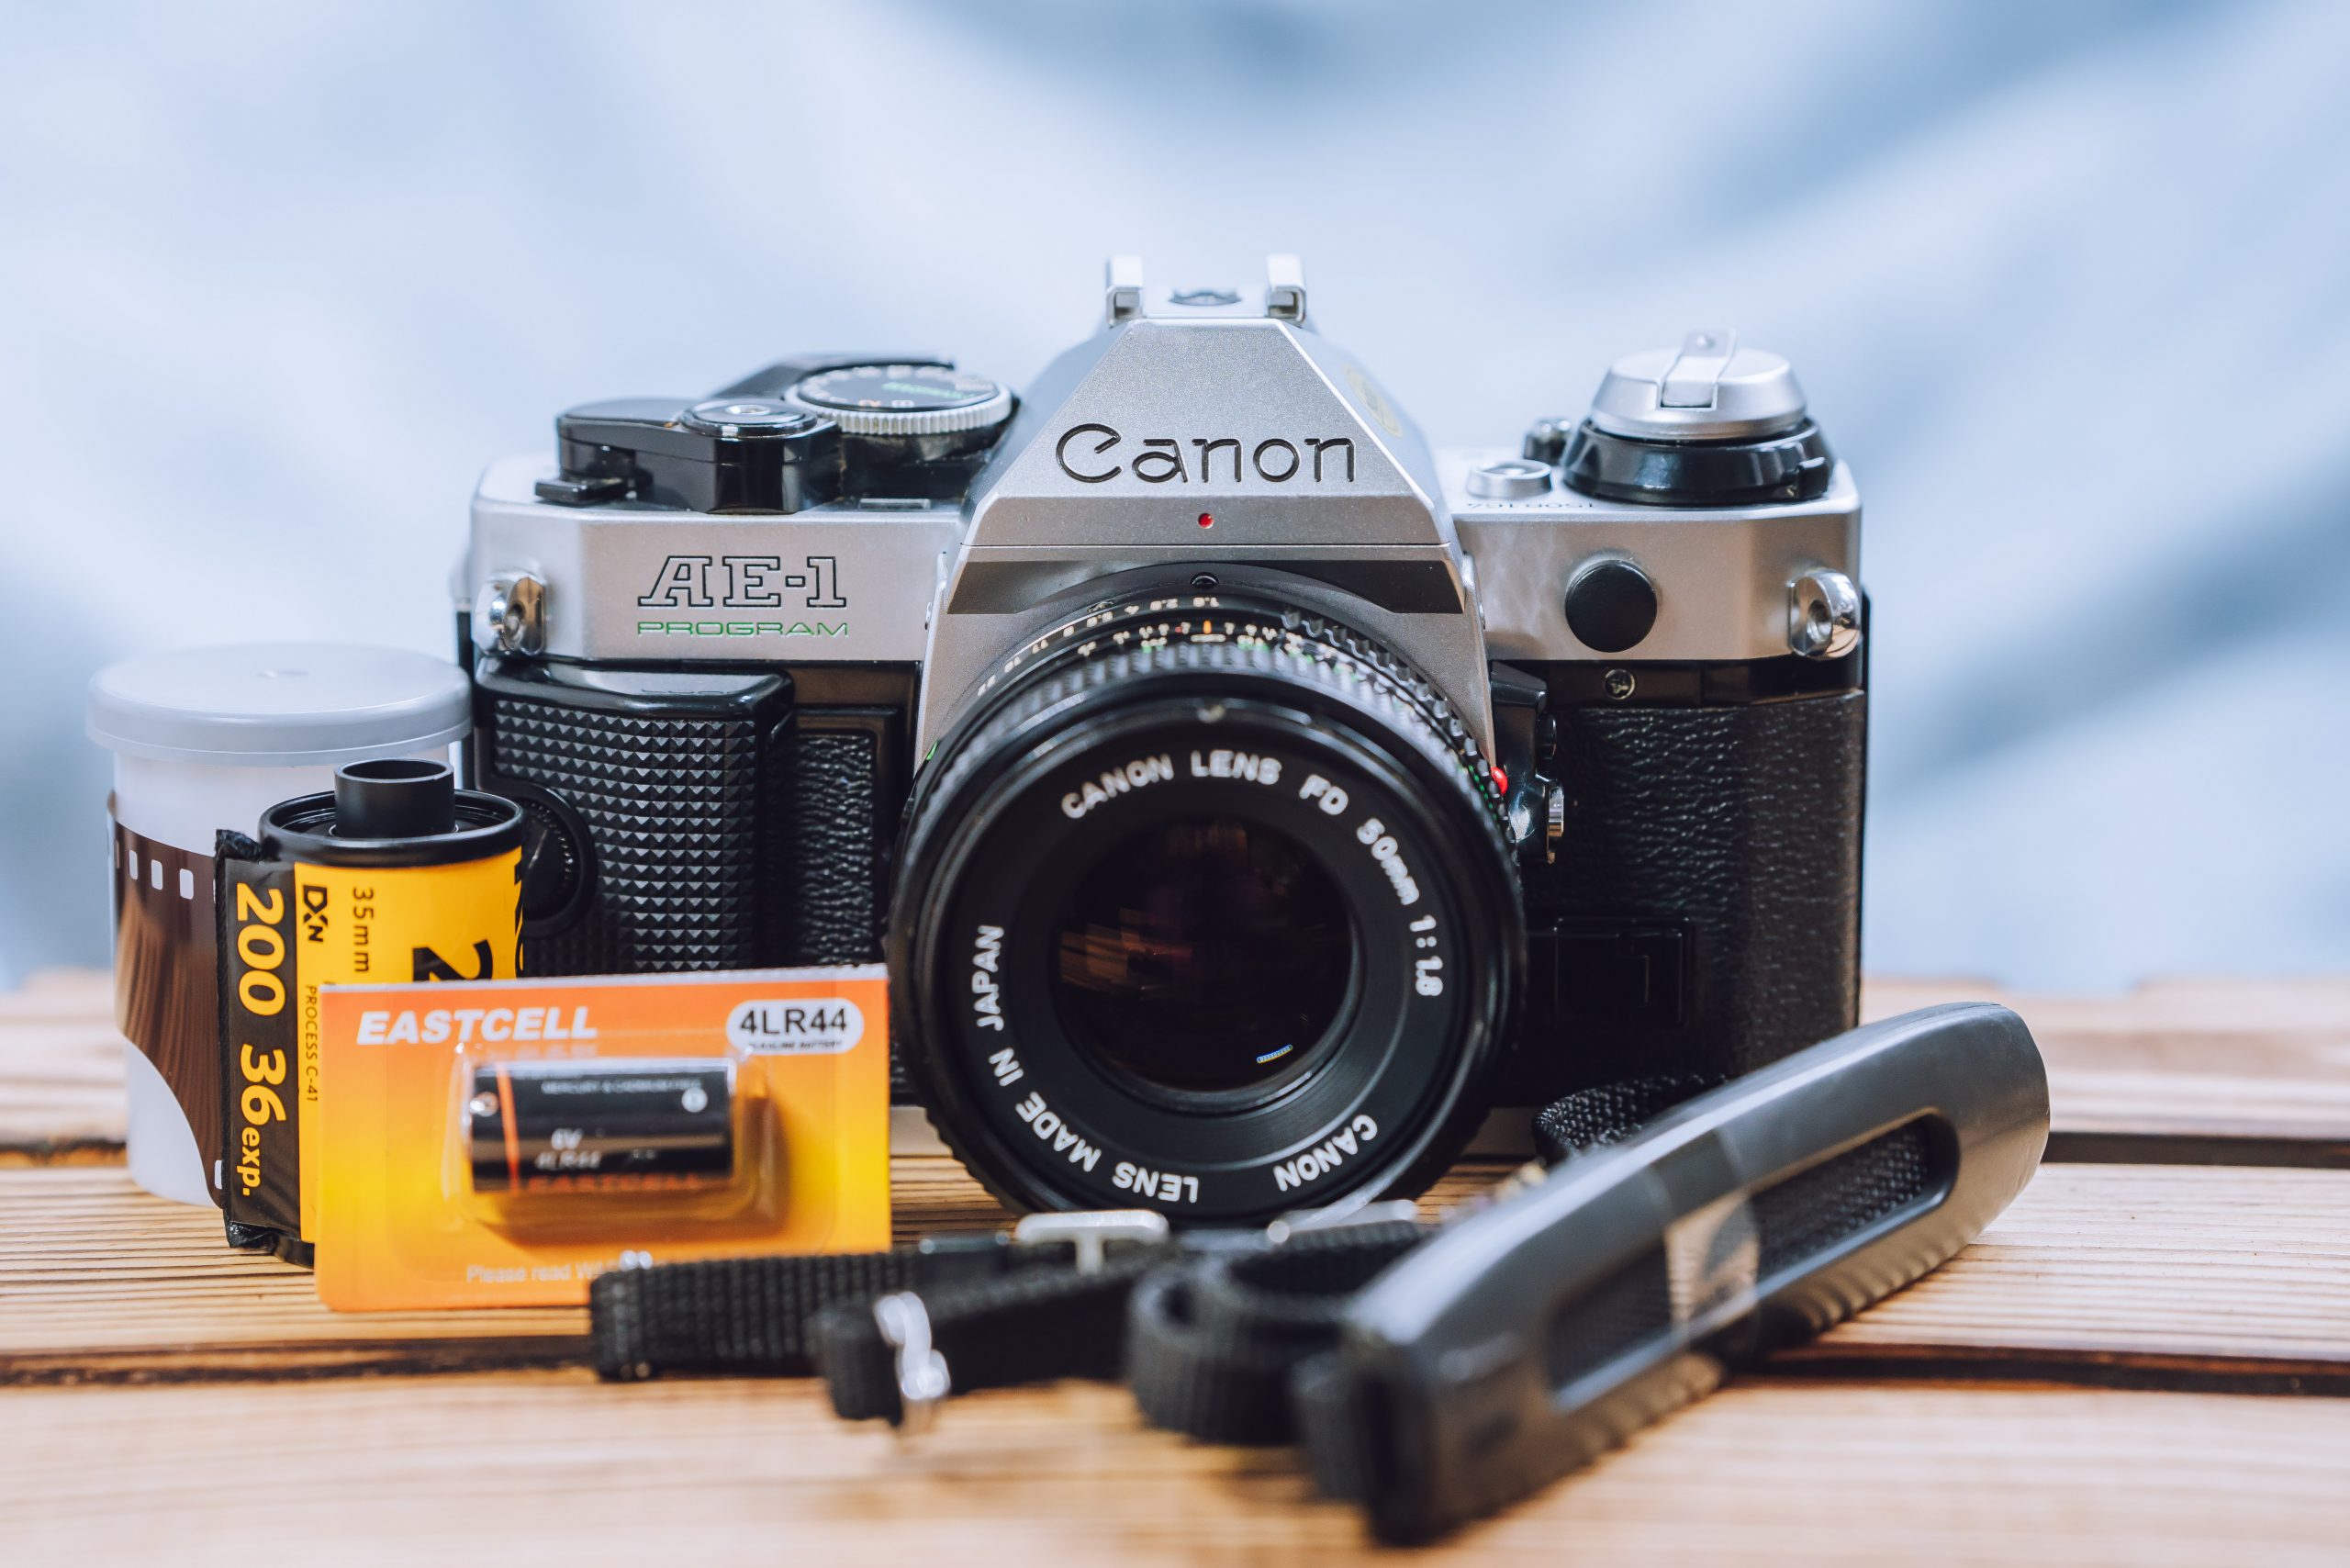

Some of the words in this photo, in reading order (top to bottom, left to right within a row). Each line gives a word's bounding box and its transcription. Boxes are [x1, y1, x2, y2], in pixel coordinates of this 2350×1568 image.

[1055, 423, 1355, 484] Canon
[637, 554, 847, 608] AE-1
[637, 621, 848, 638] PROGRAM
[1060, 754, 1174, 819] CANON
[1191, 749, 1282, 785] LENS
[1299, 774, 1349, 815] FD
[1356, 818, 1419, 905] 50mm
[237, 882, 286, 1015] 200
[353, 886, 375, 973] 35mm
[971, 924, 1004, 1032] JAPAN
[305, 985, 319, 1059] PROCESS
[356, 1006, 598, 1045] EASTCELL
[740, 1007, 847, 1035] 4LR44
[306, 1066, 319, 1103] C-41
[989, 1047, 1024, 1087] IN
[1015, 1092, 1102, 1172] MADE
[1273, 1113, 1379, 1192] CANON
[1112, 1162, 1199, 1203] LENS
[465, 1264, 526, 1283] Please
[532, 1261, 571, 1282] read
